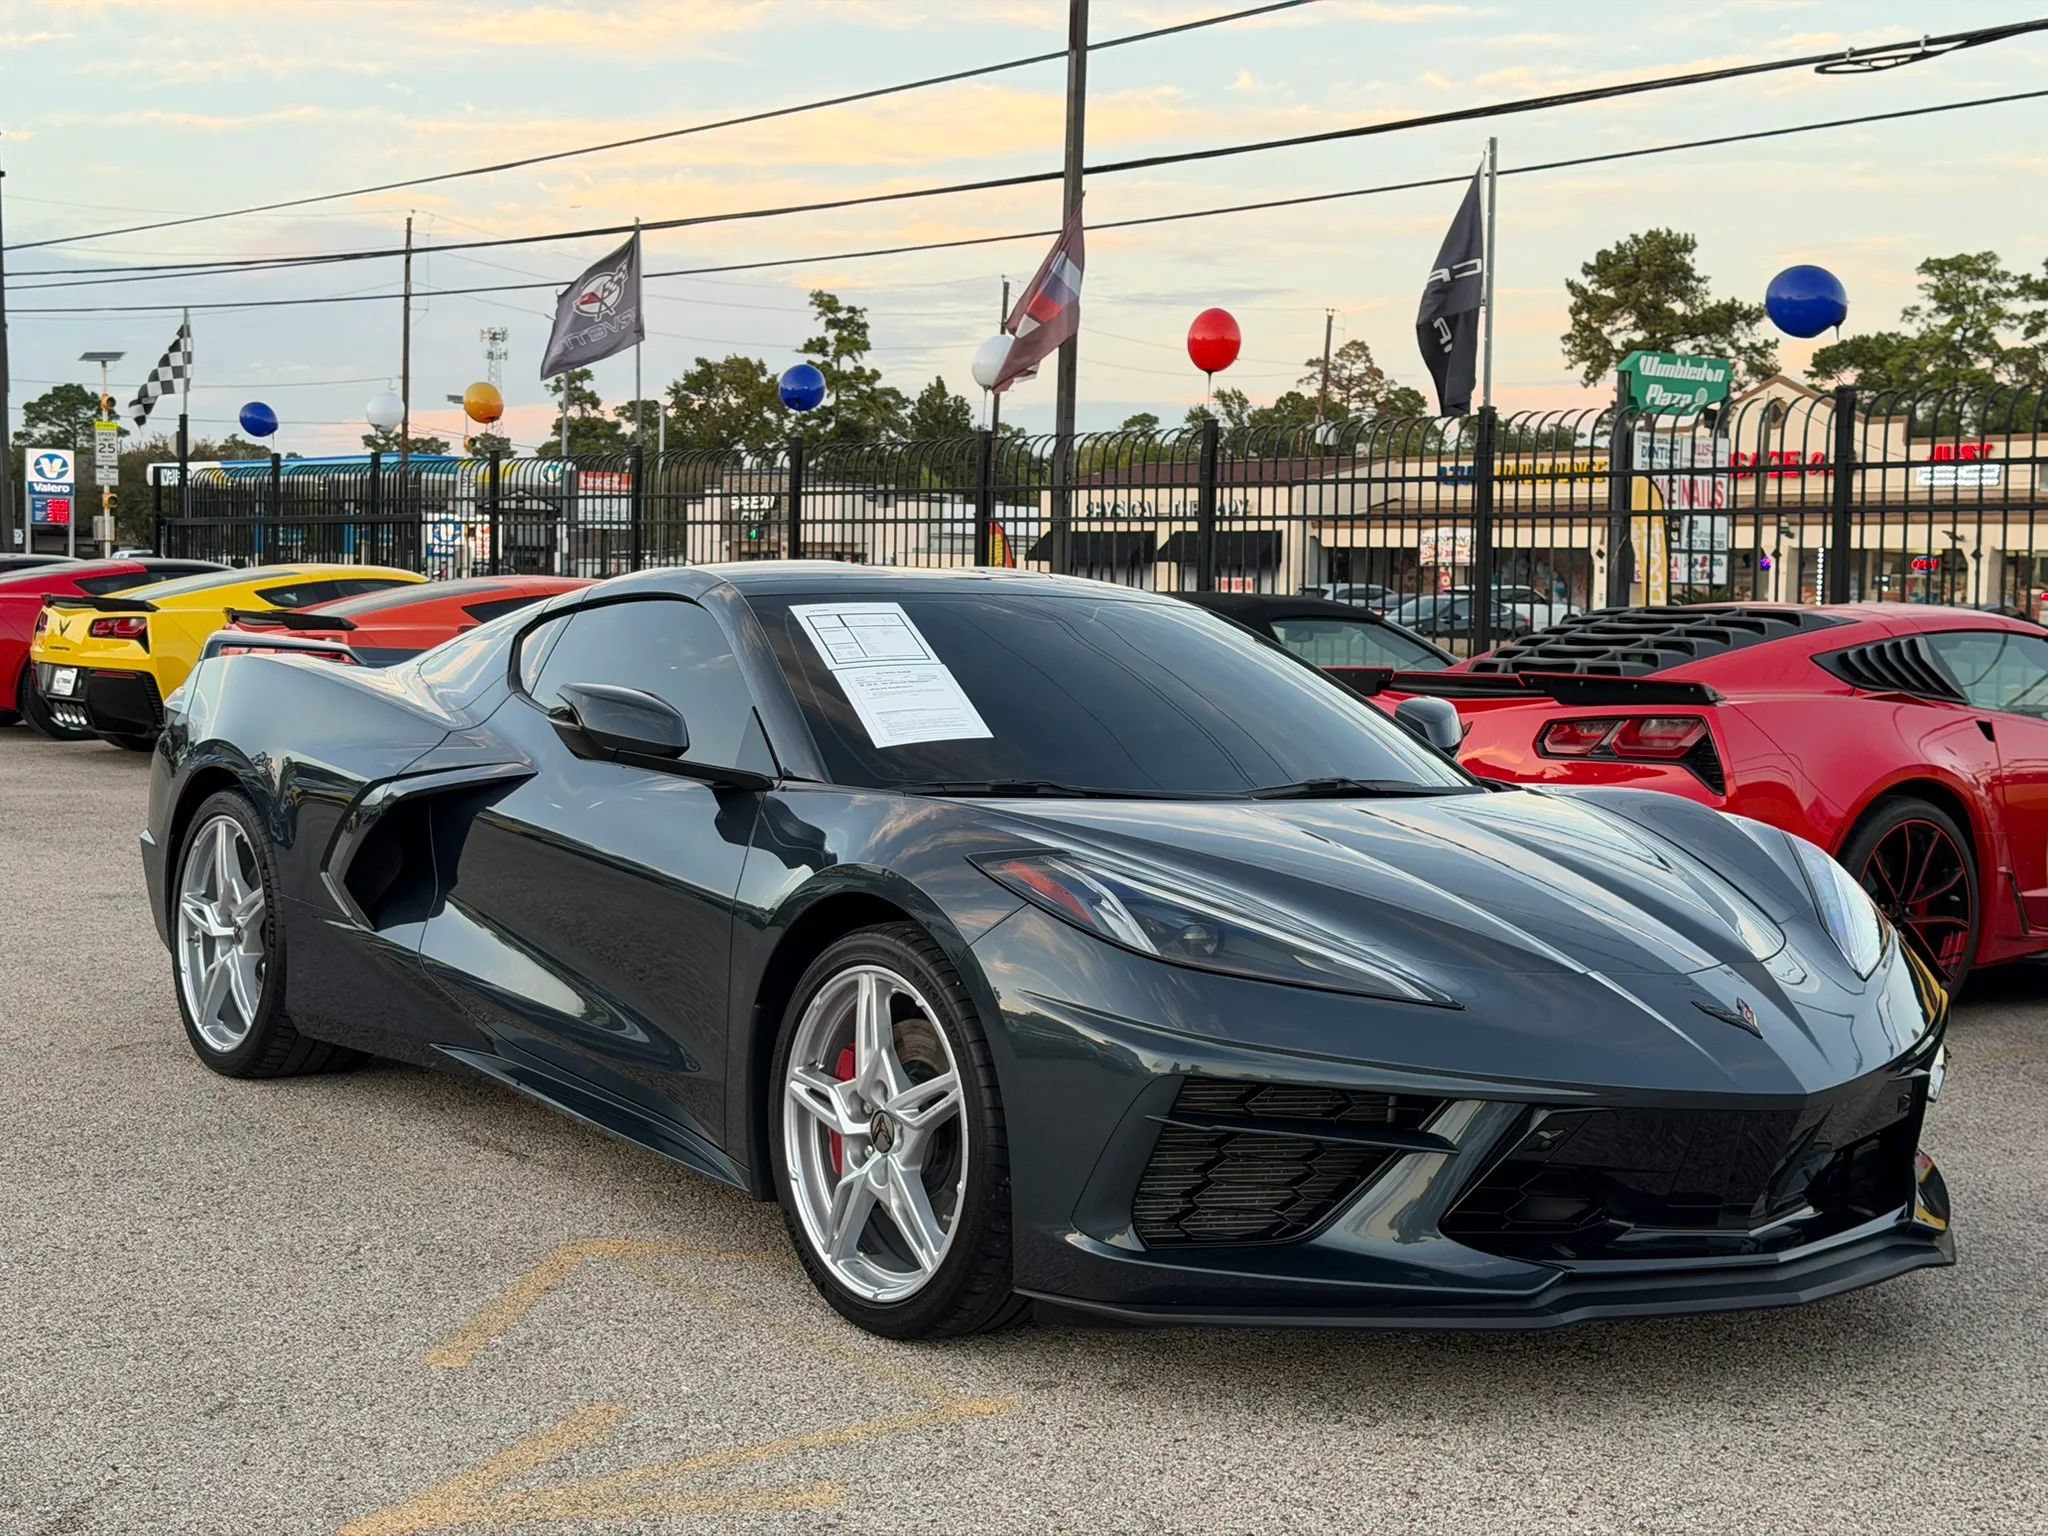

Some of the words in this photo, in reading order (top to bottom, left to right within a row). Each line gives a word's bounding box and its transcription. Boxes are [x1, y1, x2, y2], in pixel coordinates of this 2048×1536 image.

[1639, 354, 1726, 383] Wimbledon
[1645, 383, 1694, 408] Plaza
[98, 443, 116, 454] 25
[1641, 445, 1680, 460] DNTIT
[32, 482, 71, 494] Valero
[1681, 478, 1725, 509] NAILS
